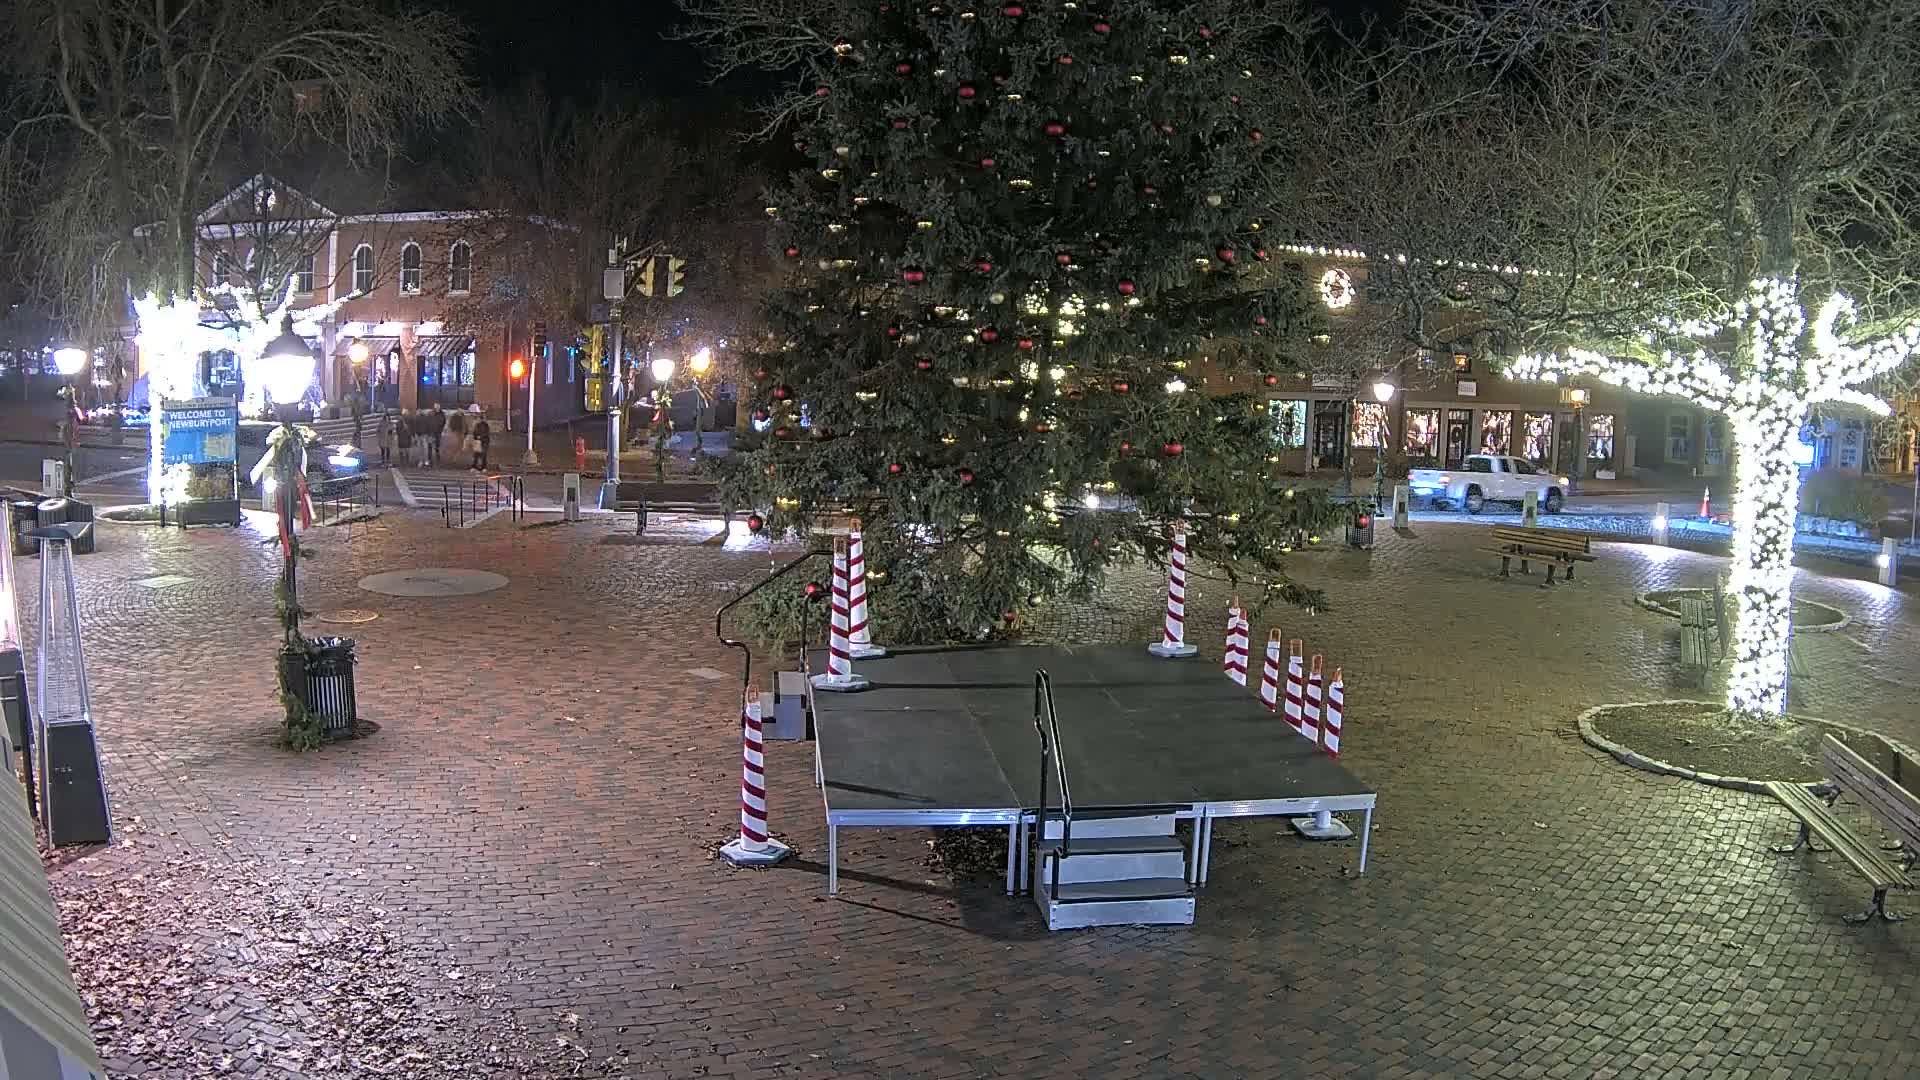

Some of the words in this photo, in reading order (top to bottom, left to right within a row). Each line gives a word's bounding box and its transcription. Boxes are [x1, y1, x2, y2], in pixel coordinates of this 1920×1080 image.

[169, 410, 212, 420] WELCOME
[214, 409, 226, 418] TO
[168, 418, 232, 429] NEWBURYPORT
